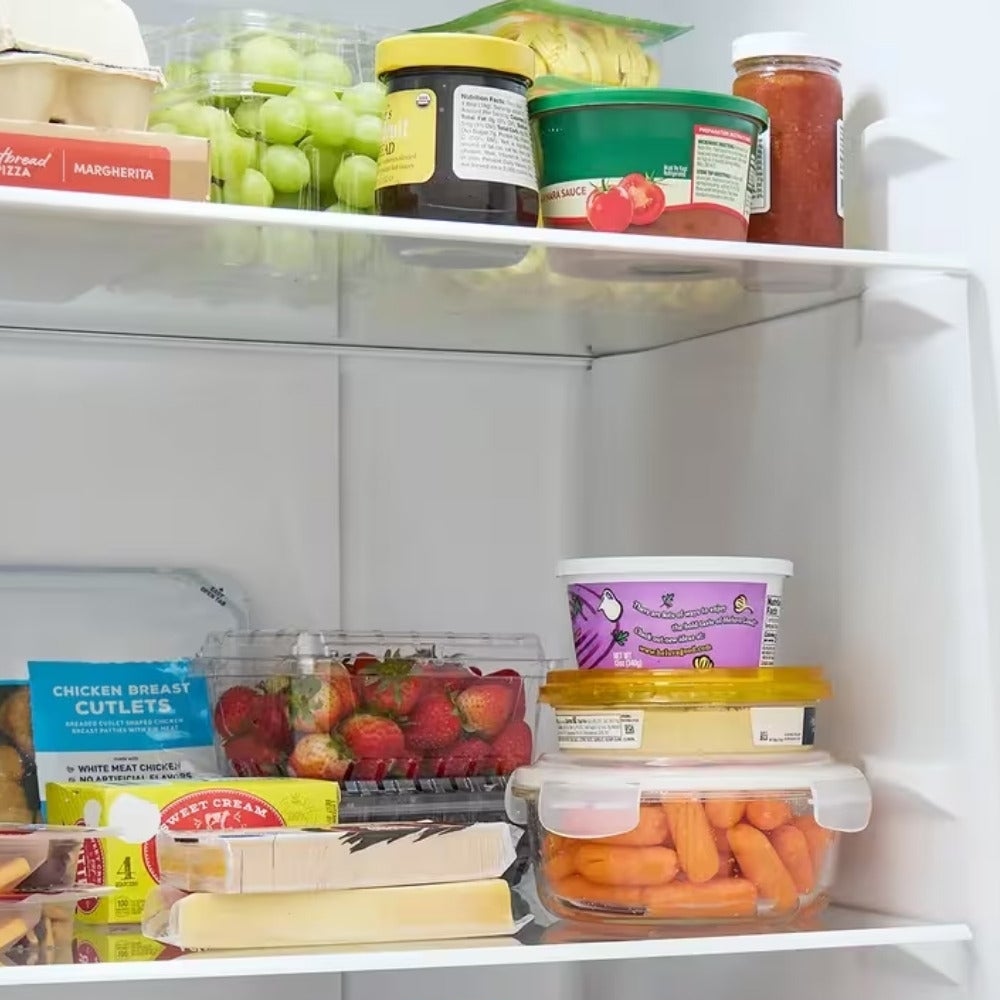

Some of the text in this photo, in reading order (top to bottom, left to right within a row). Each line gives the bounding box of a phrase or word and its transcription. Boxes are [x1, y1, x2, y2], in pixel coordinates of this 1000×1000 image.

[74, 162, 154, 181] MARGHERITA
[561, 186, 587, 198] SAUCE
[53, 682, 190, 697] CHICKEN BREAST
[75, 698, 172, 715] CUTLETS
[65, 720, 98, 728] BREADED
[78, 762, 181, 773] WHITE MEAT CHICKEN
[159, 798, 269, 832] SWEET CREAM
[116, 856, 137, 880] 4
